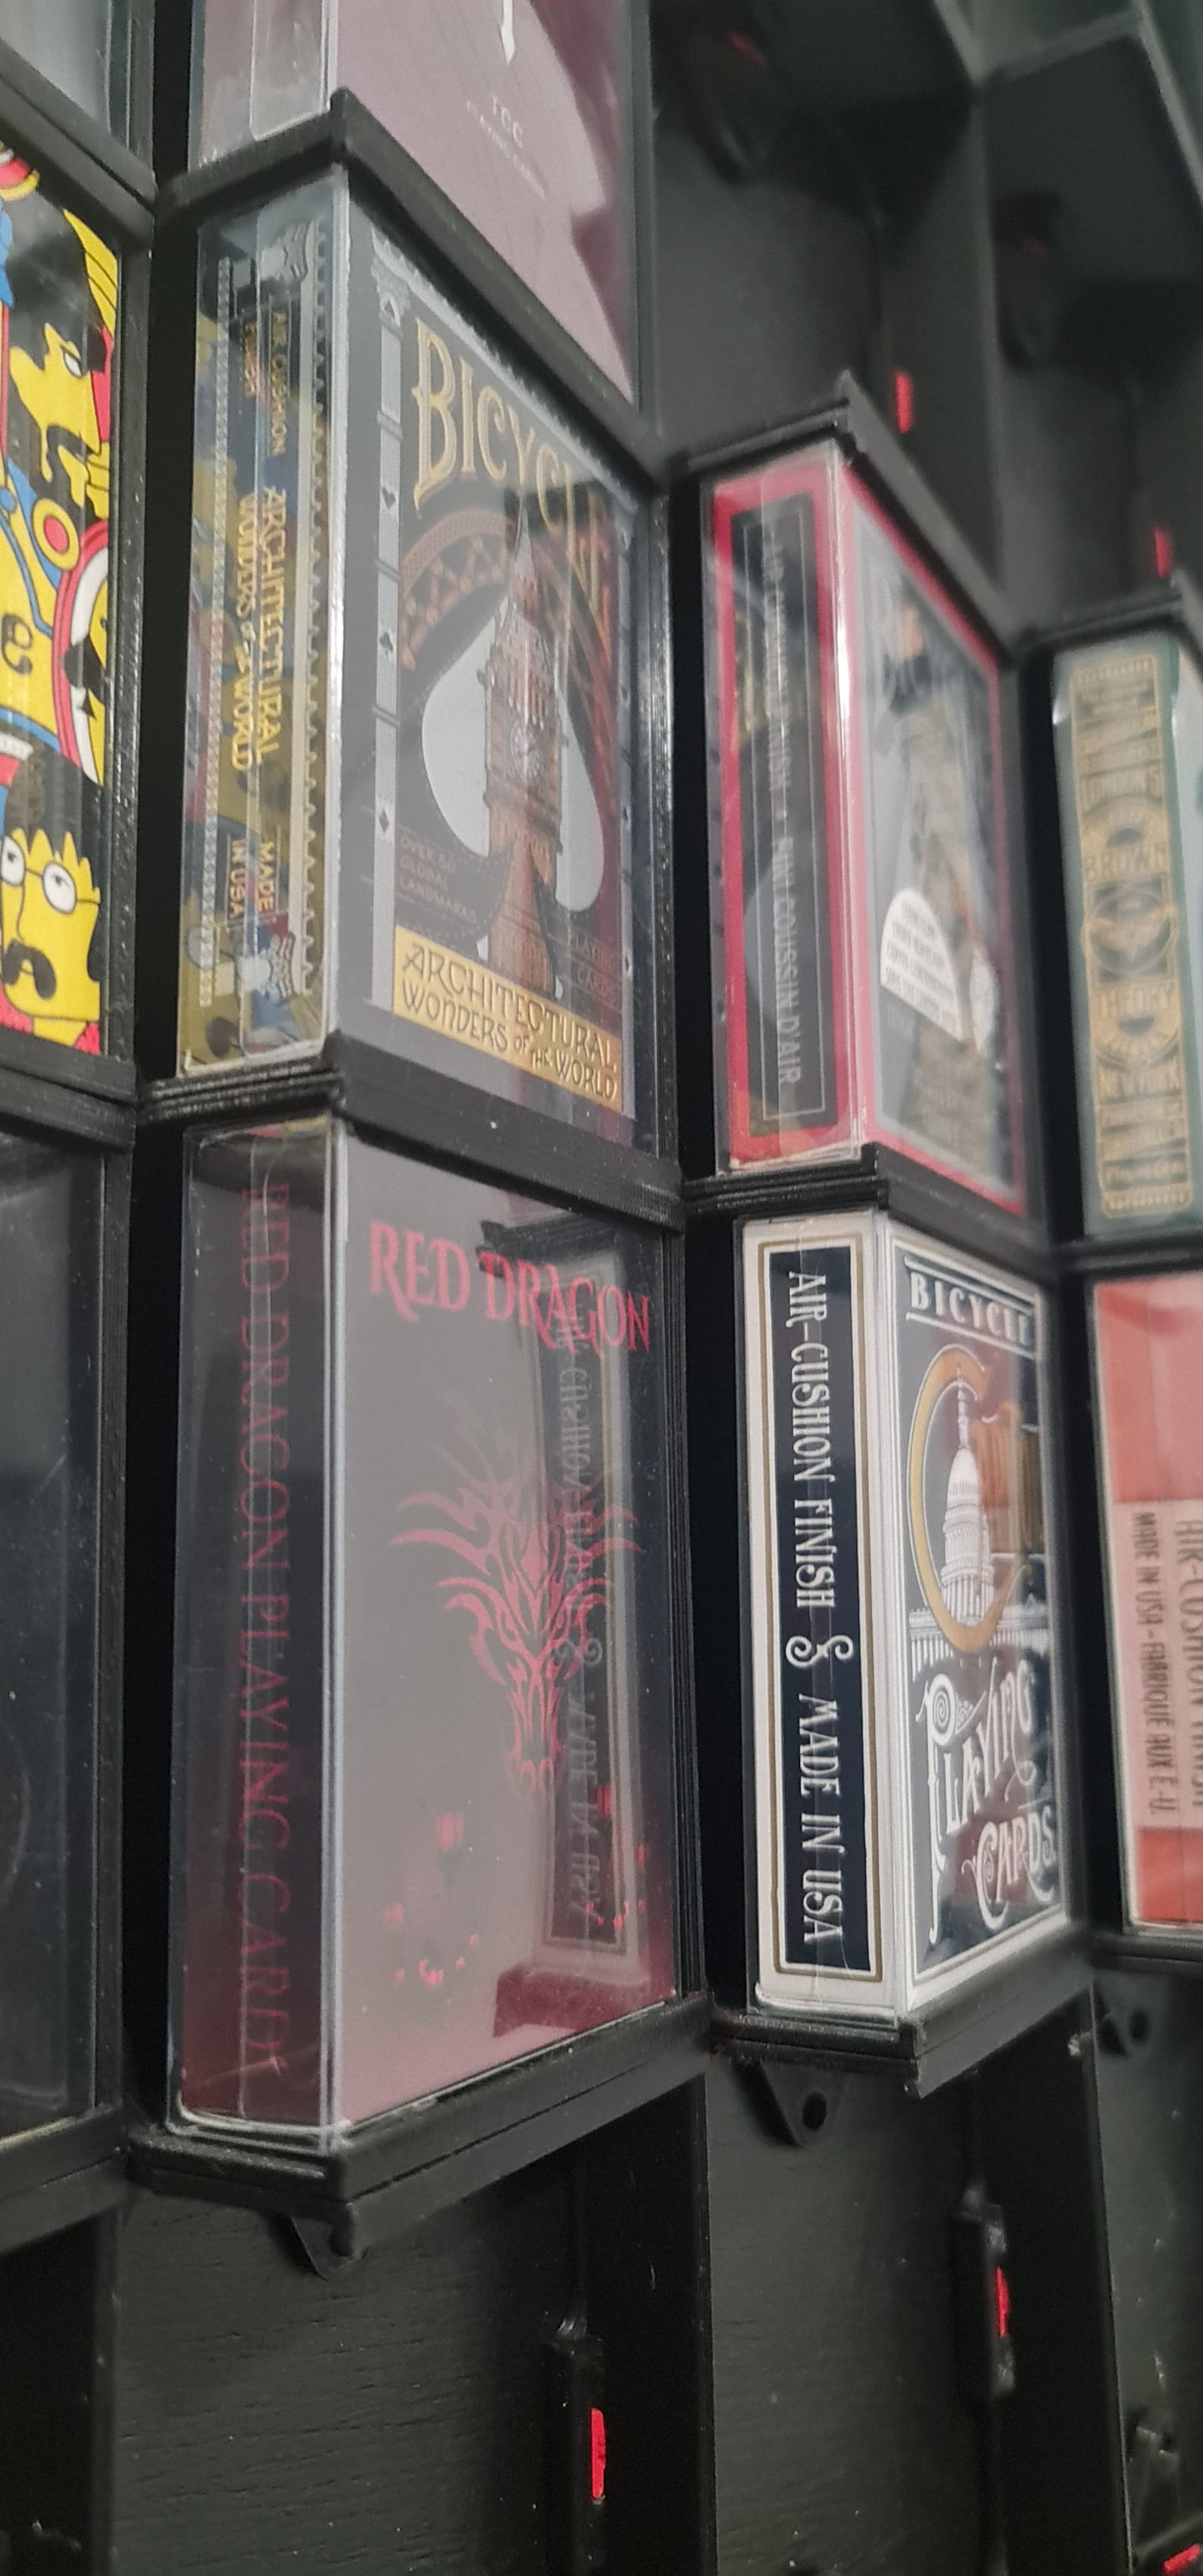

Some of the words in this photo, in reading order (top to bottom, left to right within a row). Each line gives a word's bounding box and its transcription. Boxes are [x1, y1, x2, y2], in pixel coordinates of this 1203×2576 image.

[256, 486, 288, 764] ARCHITECTURAL
[258, 841, 274, 911] MADE
[402, 943, 617, 1073] ARCHITECTURAL
[402, 977, 509, 1052] WONDERS
[514, 1033, 532, 1056] OF
[531, 1047, 552, 1069] THE
[554, 1048, 618, 1102] WORLD
[240, 1182, 290, 1293] RED
[369, 1221, 471, 1322] RED
[477, 1250, 651, 1359] DRAGON
[911, 1271, 1031, 1348] BICYCLE
[785, 1270, 836, 1483] AIR-CUSHION
[239, 1312, 291, 1570] DRAGON
[794, 1499, 839, 1608] FINISH
[1136, 1591, 1164, 1624] USA
[1138, 1566, 1161, 1583] IN
[237, 1593, 290, 1850] PLAYING
[798, 1693, 841, 1796] MADE
[801, 1812, 845, 1855] IN
[915, 1656, 1036, 1945] PLAYING
[802, 1869, 844, 1943] USA
[962, 1804, 1055, 1930] CARDS
